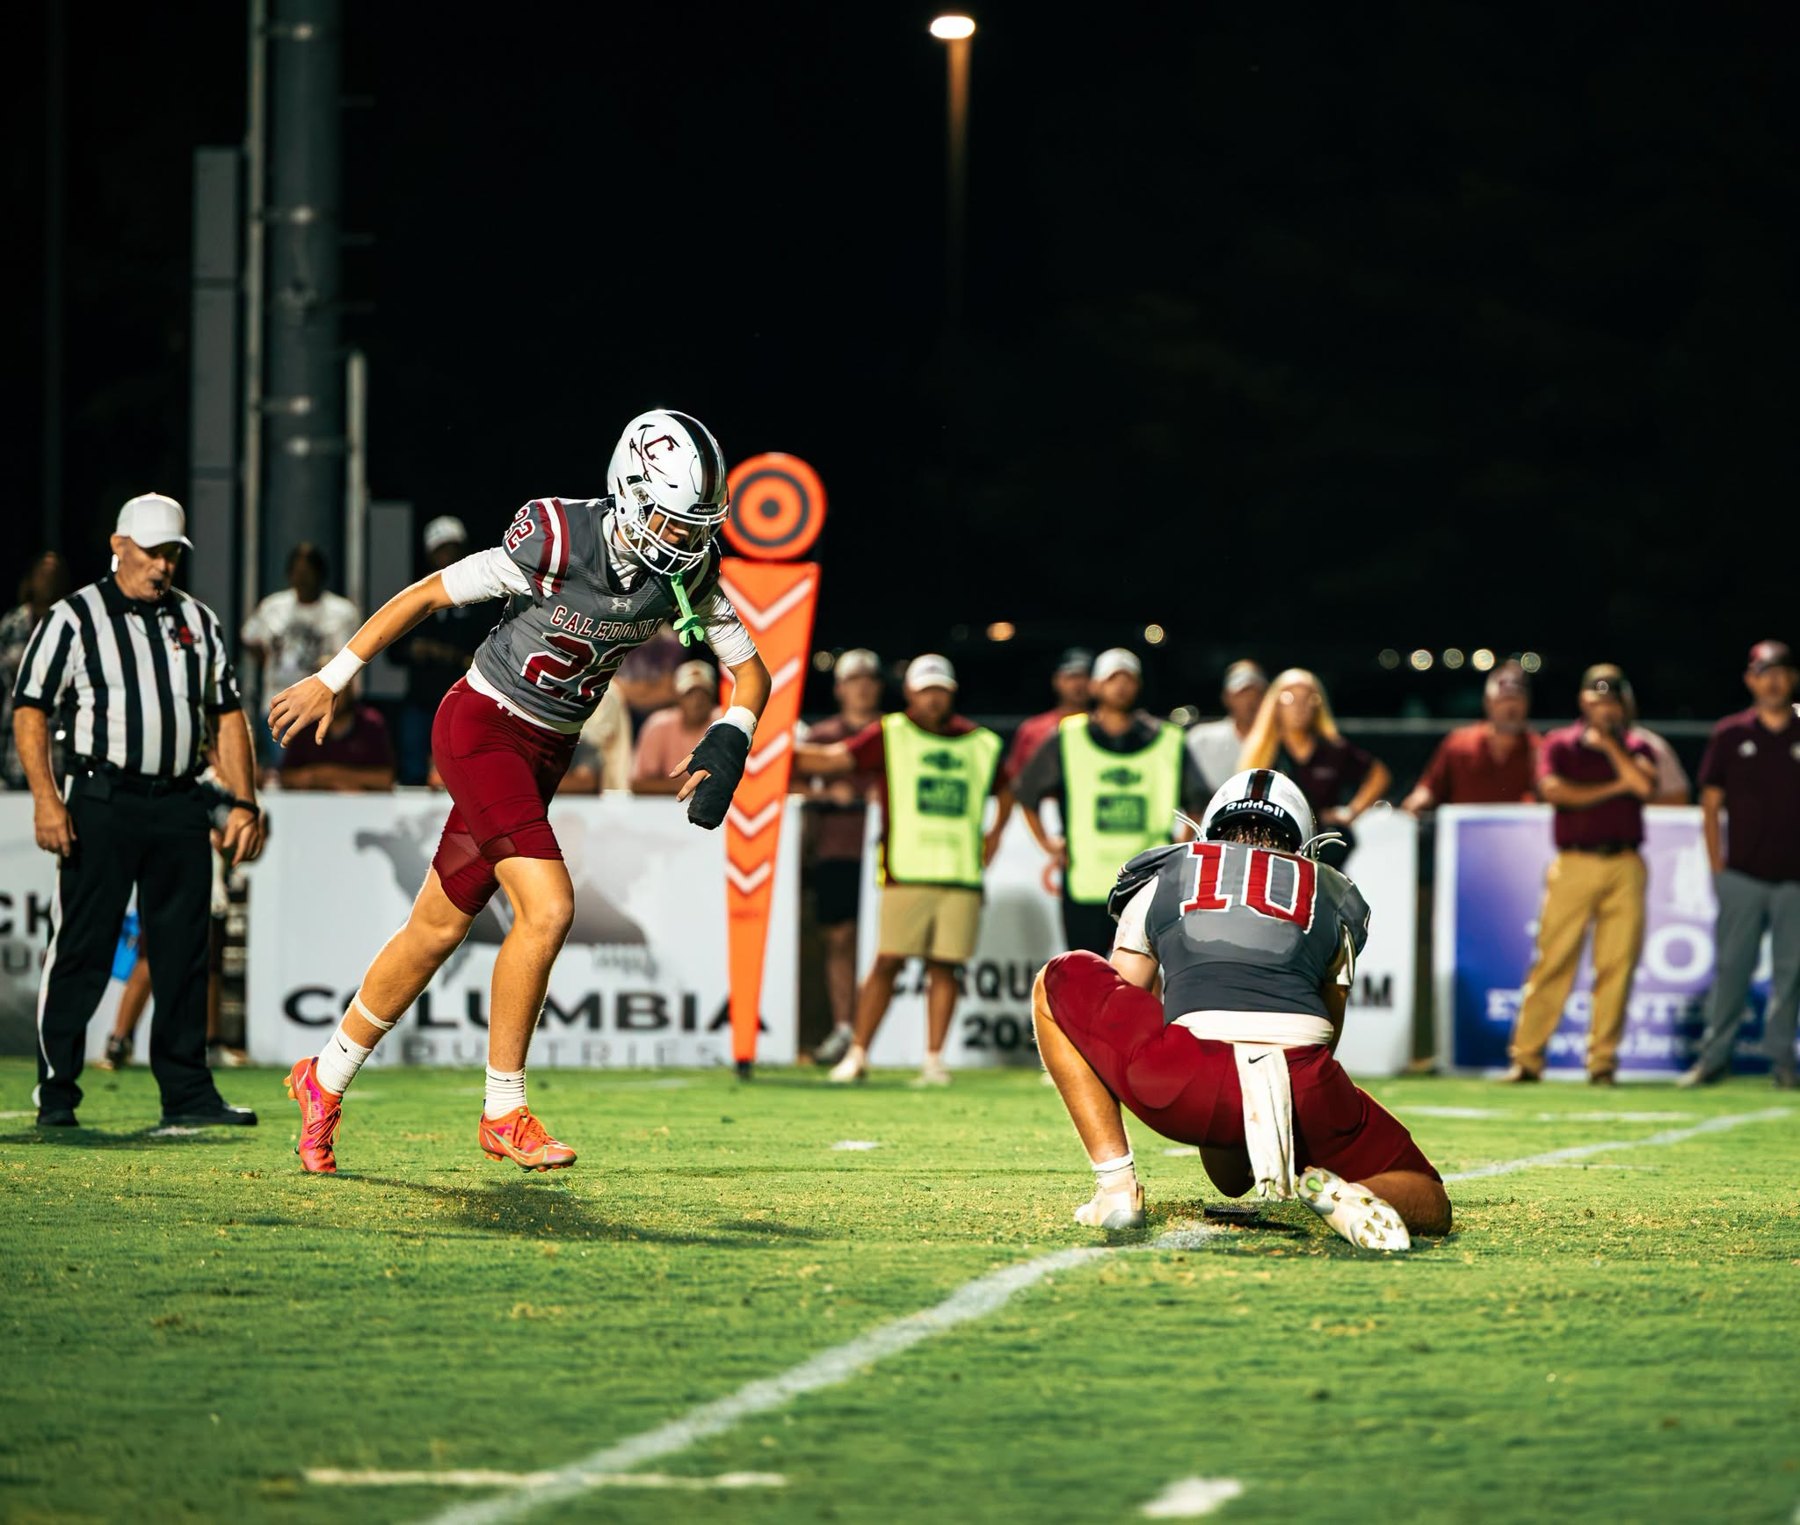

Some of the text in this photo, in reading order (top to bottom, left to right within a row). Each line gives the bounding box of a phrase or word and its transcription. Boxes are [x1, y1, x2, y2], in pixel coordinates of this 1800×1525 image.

[550, 604, 665, 642] CALEDONIA
[1225, 799, 1285, 818] Riddell
[1179, 841, 1319, 934] 10
[284, 986, 769, 1032] CLUMBIA
